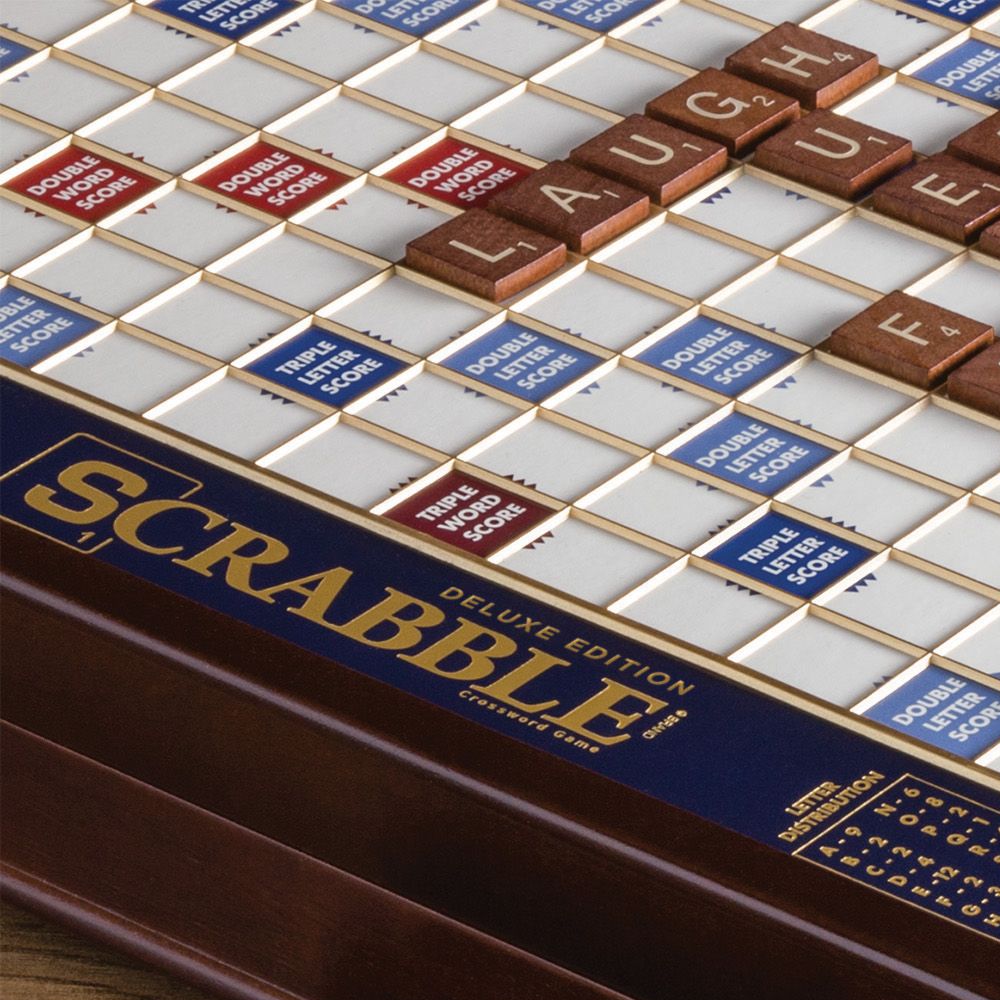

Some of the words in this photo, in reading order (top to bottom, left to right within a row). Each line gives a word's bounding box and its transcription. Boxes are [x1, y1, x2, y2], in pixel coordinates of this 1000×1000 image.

[935, 48, 1000, 87] DOUBLE
[26, 155, 101, 196] DOUBLE
[52, 168, 115, 201] WORD
[217, 151, 290, 192] DOUBLE
[243, 164, 305, 197] WORD
[407, 147, 479, 188] DOUBLE
[433, 159, 494, 193] WORD
[457, 168, 518, 202] SCORE
[75, 175, 138, 210] SCORE
[267, 171, 328, 206] SCORE
[9, 317, 74, 353] SCORE
[661, 327, 733, 370] DOUBLE
[274, 340, 338, 375] TRIPLE
[297, 349, 361, 386] LETTER
[464, 332, 538, 376] DOUBLE
[493, 345, 555, 381] LETTER
[516, 353, 578, 390] SCORE
[689, 340, 751, 376] LETTER
[713, 348, 773, 385] SCORE
[320, 358, 383, 395] SCORE
[695, 423, 769, 468] DOUBLE
[724, 437, 786, 474] LETTER
[748, 445, 810, 484] SCORE
[415, 484, 480, 521] TRIPLE
[436, 494, 502, 532] WORD
[462, 502, 527, 542] SCORE
[738, 527, 801, 564] TRIPLE
[761, 537, 825, 576] LETTER
[786, 545, 849, 585] SCORE
[24, 460, 669, 746] SCRABBLE
[439, 586, 560, 641] DELUXE
[564, 637, 695, 697] EDITION
[891, 677, 967, 726] DOUBLE
[922, 692, 987, 732] LETTER
[458, 689, 550, 732] Crossword
[553, 730, 600, 753] Game
[778, 770, 885, 843] DISTRIBUTION
[785, 781, 842, 816] LETTER
